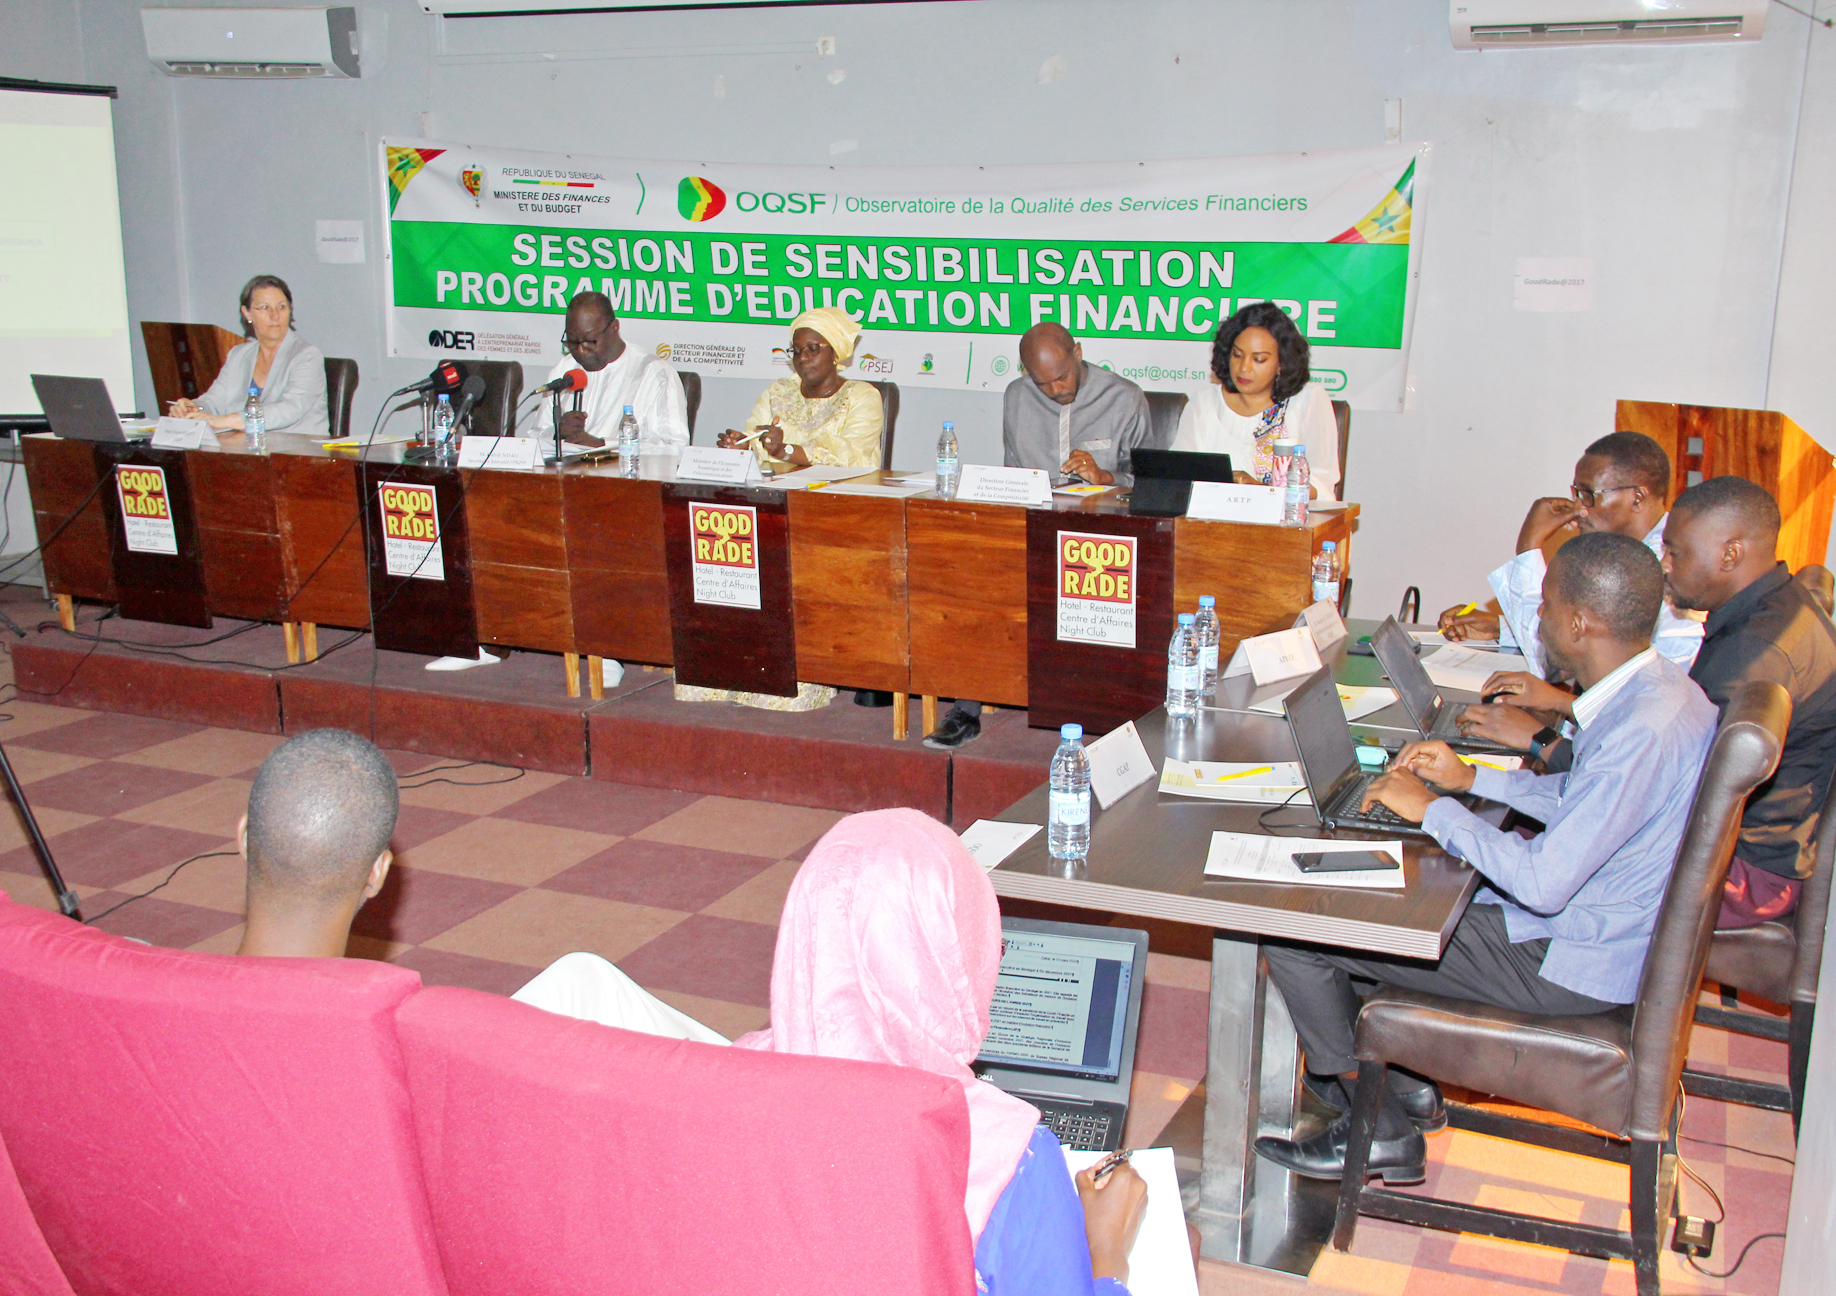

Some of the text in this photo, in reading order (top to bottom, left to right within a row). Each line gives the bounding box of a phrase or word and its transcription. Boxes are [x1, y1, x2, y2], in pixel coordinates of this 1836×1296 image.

[502, 168, 606, 180] REPUBLIQUE DU SENEGAL
[494, 190, 610, 204] MINISTERE DES FINANCES
[736, 191, 1308, 214] OQSF Observatoire de la Qualité des Services Financiers
[518, 203, 582, 213] ET DU BUDGET
[510, 232, 1235, 288] SESSION DE SENSIBILISATION
[436, 270, 694, 315] PROGRAMME
[1030, 293, 1338, 339] FINANCIRE
[694, 357, 744, 365] COMPÉTITIVITÉ
[867, 361, 894, 374] PSEJ
[1122, 365, 1206, 381] oqsf@oqsf.sn
[120, 470, 162, 491] GOOD
[124, 495, 167, 516] RADE
[384, 489, 432, 512] GOOD
[387, 515, 435, 538] RADE
[695, 510, 751, 535] GOOD
[408, 542, 440, 552] Restaurant
[697, 538, 752, 564] RADE
[1064, 539, 1130, 567] GOOD
[388, 551, 408, 559] Centre
[389, 562, 406, 571] Night
[696, 566, 713, 574] Hotel
[721, 568, 757, 579] Restaurant
[696, 576, 757, 590] Centre d'Affaires
[1064, 570, 1129, 599] RADE
[697, 589, 736, 600] Night Club
[1061, 600, 1081, 610] Hotel
[1090, 603, 1133, 615] Restaurant
[1060, 612, 1133, 628] Centre d'Affaires
[1060, 625, 1106, 637] Night Club
